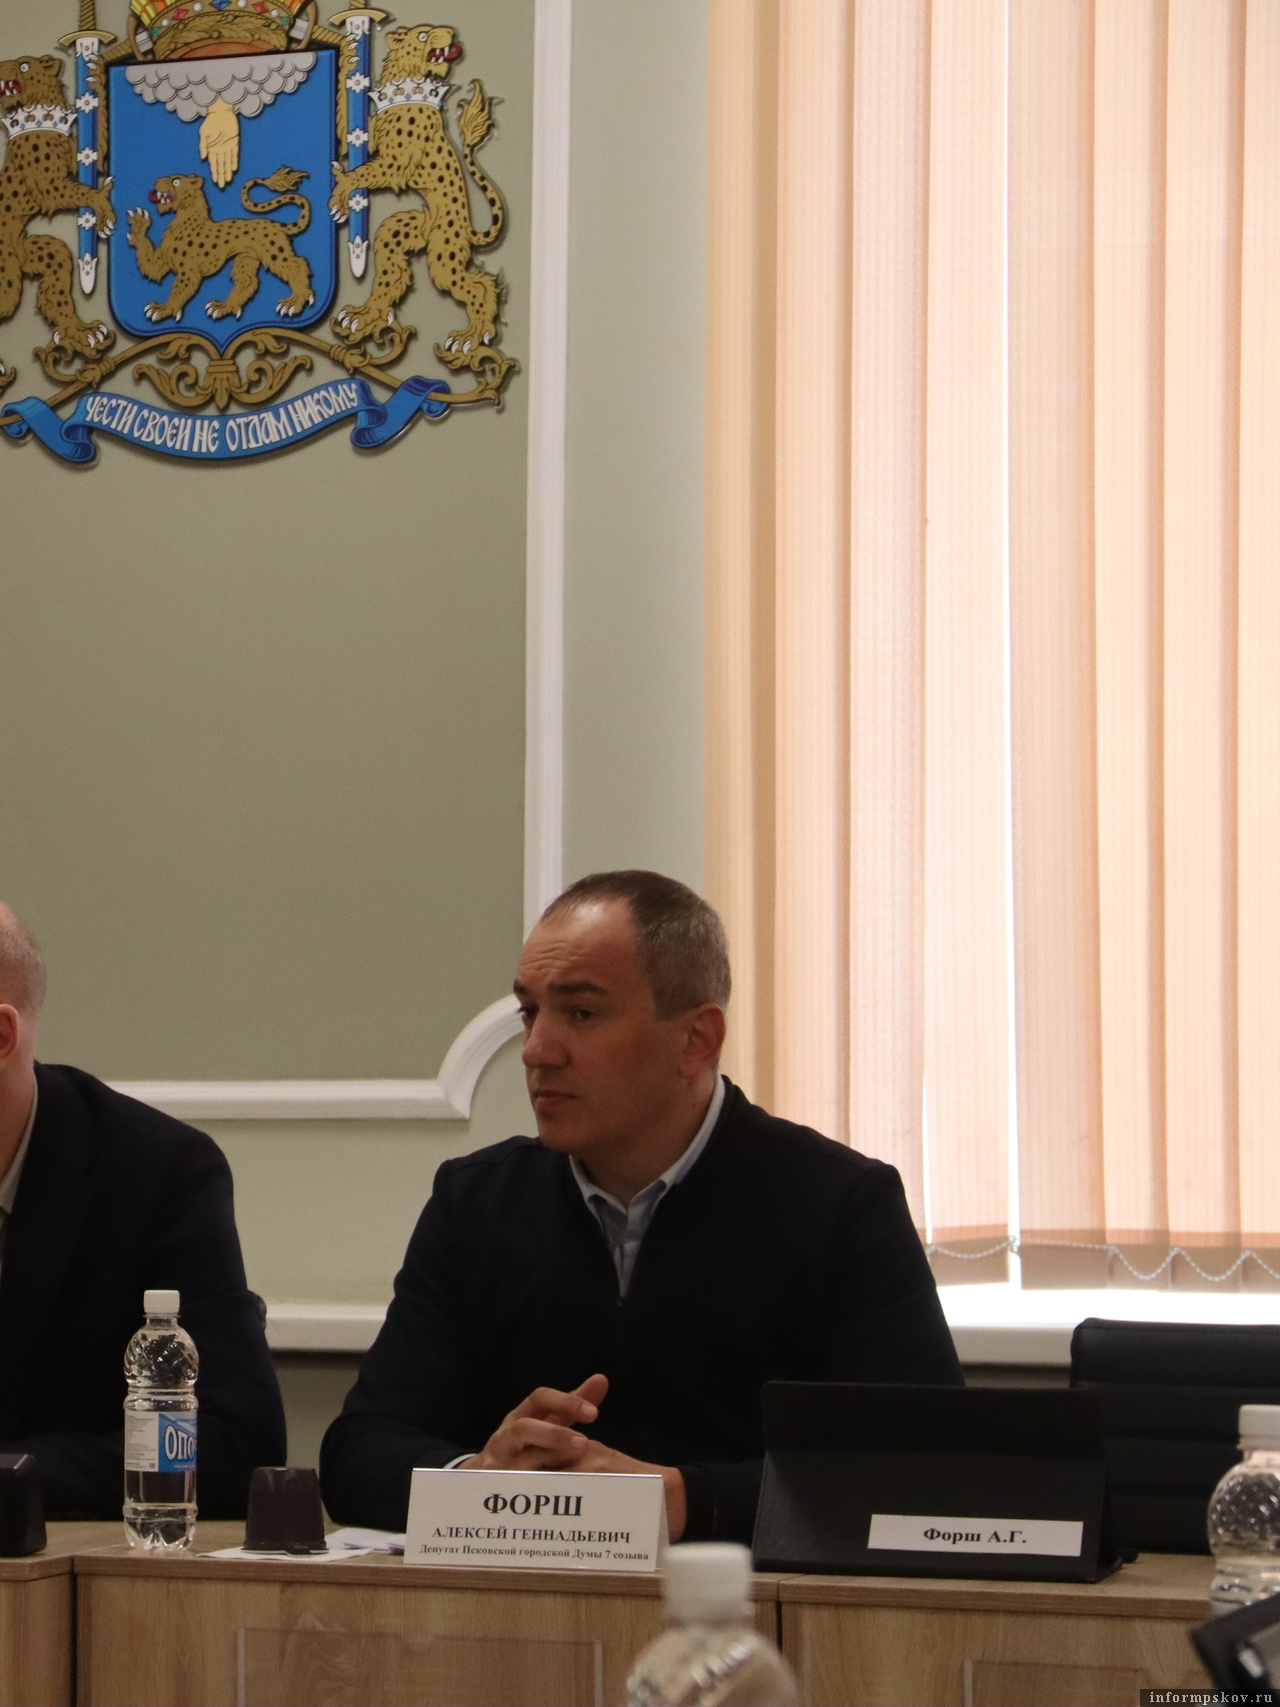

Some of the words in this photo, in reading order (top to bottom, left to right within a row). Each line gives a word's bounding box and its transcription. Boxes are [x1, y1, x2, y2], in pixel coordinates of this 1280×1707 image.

[85, 396, 139, 434] ЧЕСТИ
[192, 419, 220, 453] НЕ
[225, 407, 294, 452] ОТДАМ
[287, 383, 359, 433] НИКОМУ
[483, 1493, 583, 1516] ФОРШ
[432, 1525, 508, 1540] АЛЕКСЕЙ
[511, 1529, 631, 1544] ГЕННАДЬЕВИЧ
[923, 1528, 981, 1544] Форш
[987, 1530, 1027, 1543] А.Г.
[419, 1545, 460, 1555] Депутат
[463, 1545, 517, 1555] Псковской
[519, 1547, 570, 1558] городской
[572, 1548, 602, 1559] Думы
[606, 1550, 612, 1559] 7
[613, 1551, 649, 1560] созыва
